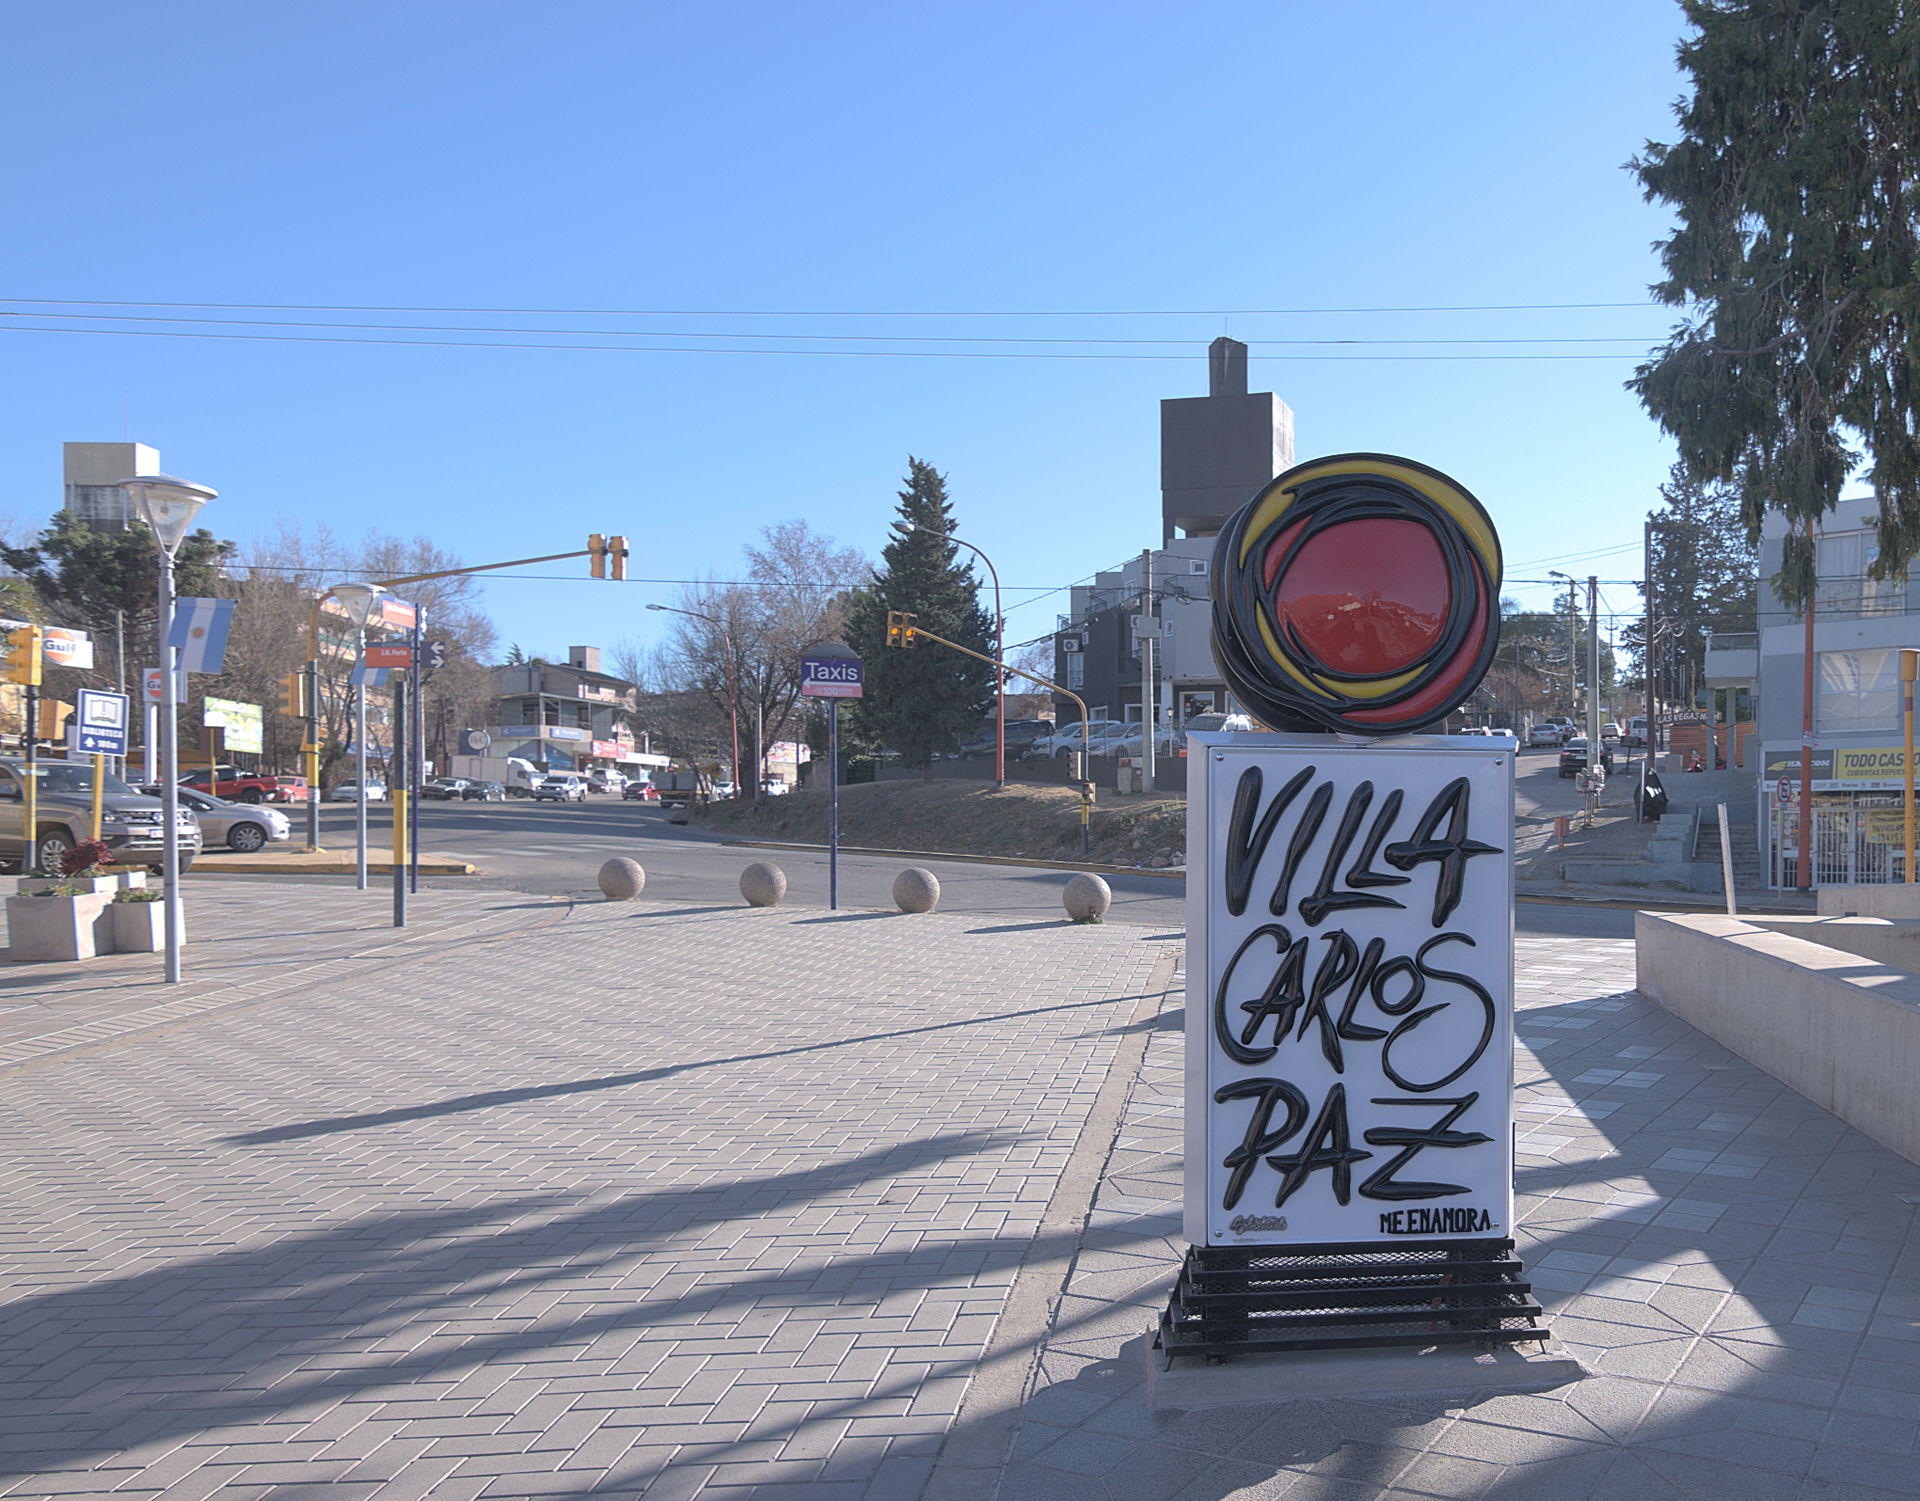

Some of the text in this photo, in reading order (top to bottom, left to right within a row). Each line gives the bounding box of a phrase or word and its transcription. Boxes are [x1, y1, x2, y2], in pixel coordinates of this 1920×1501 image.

[44, 639, 76, 653] Gulf
[805, 662, 858, 681] Taxis
[1657, 714, 1672, 723] LAS
[1673, 711, 1699, 721] VEGAS
[1844, 752, 1920, 768] TODO CASO
[1225, 765, 1504, 927] VILLA
[1215, 923, 1496, 1092] CARLOS
[1214, 1077, 1496, 1211] PAZ
